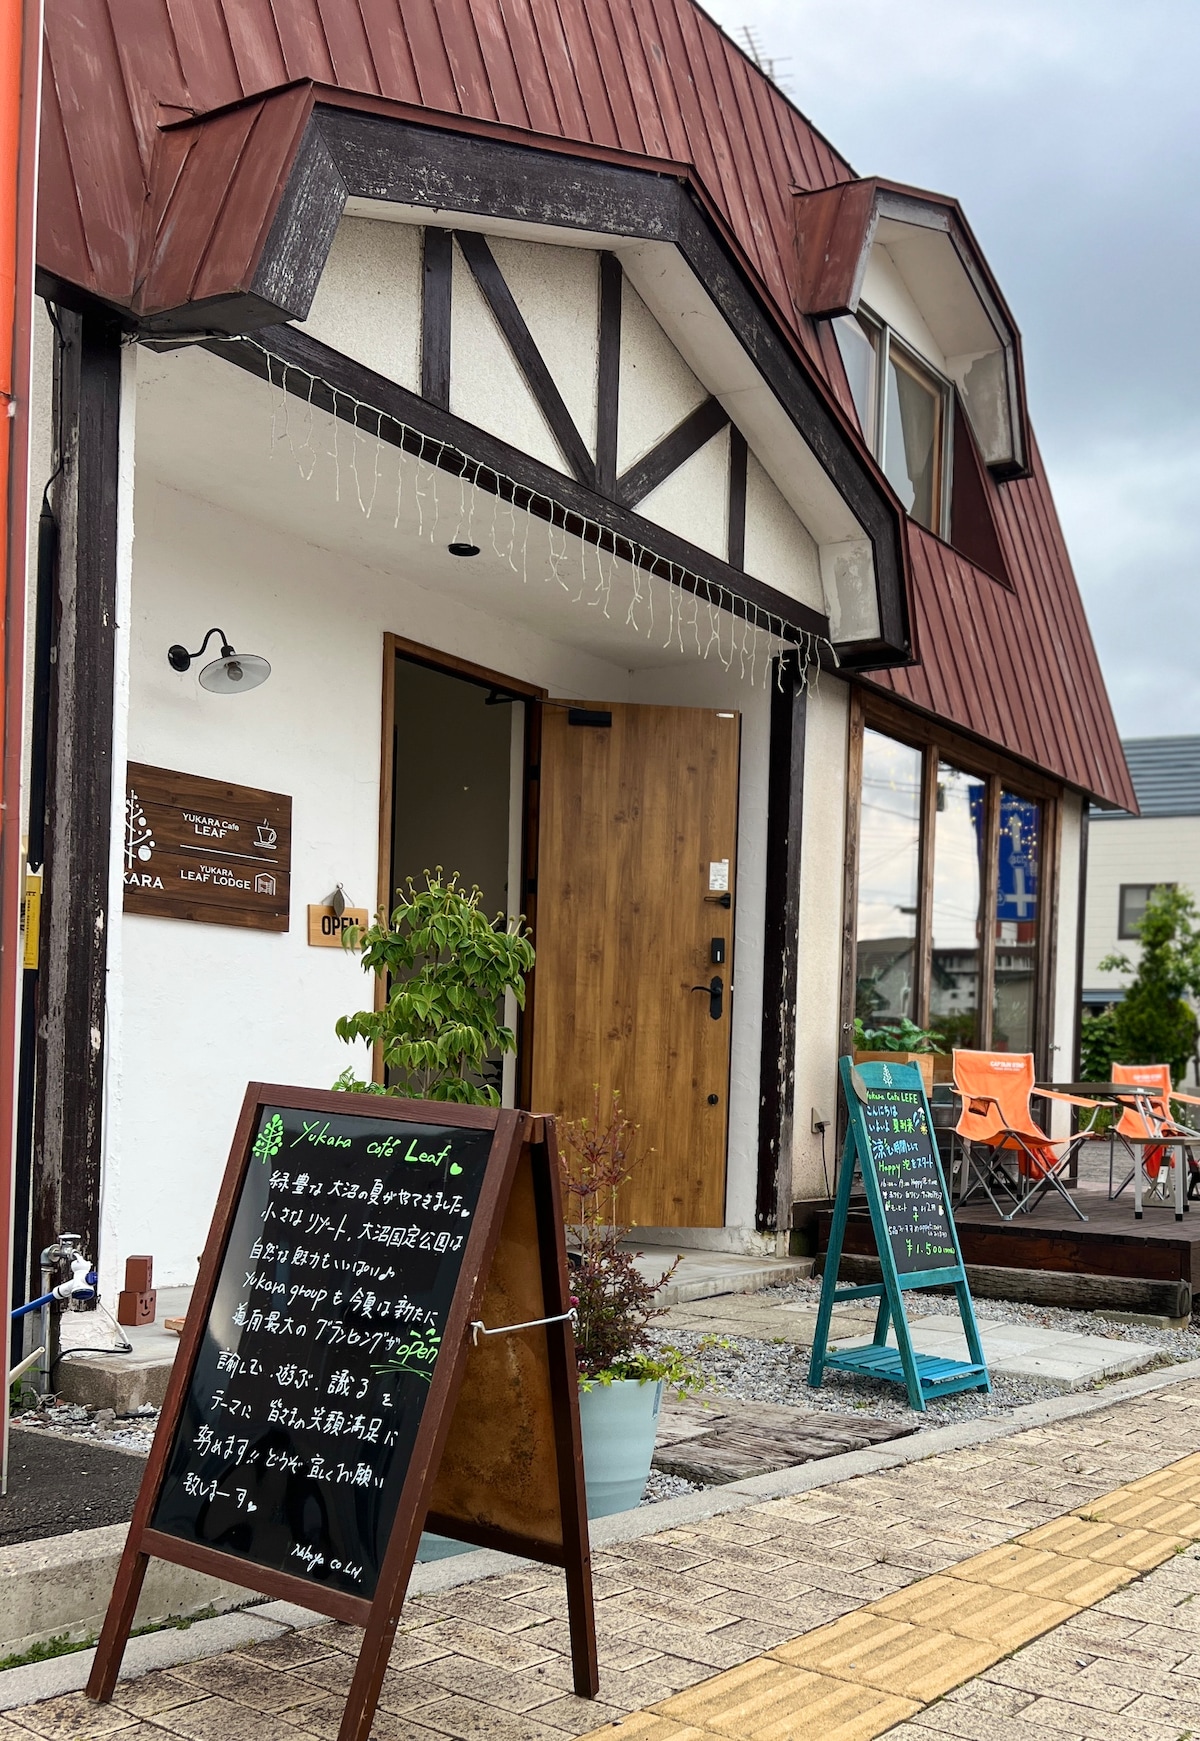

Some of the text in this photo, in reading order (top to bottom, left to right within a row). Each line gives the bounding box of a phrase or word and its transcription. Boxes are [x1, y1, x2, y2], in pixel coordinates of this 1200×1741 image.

[182, 813, 240, 832] YUKARA Cafe
[194, 823, 228, 839] LEAF
[180, 869, 251, 890] LEAF LODGE
[200, 865, 234, 878] YUKARA
[289, 1121, 352, 1148] Yukara
[404, 1139, 452, 1167] Leaf
[286, 1284, 328, 1312] group
